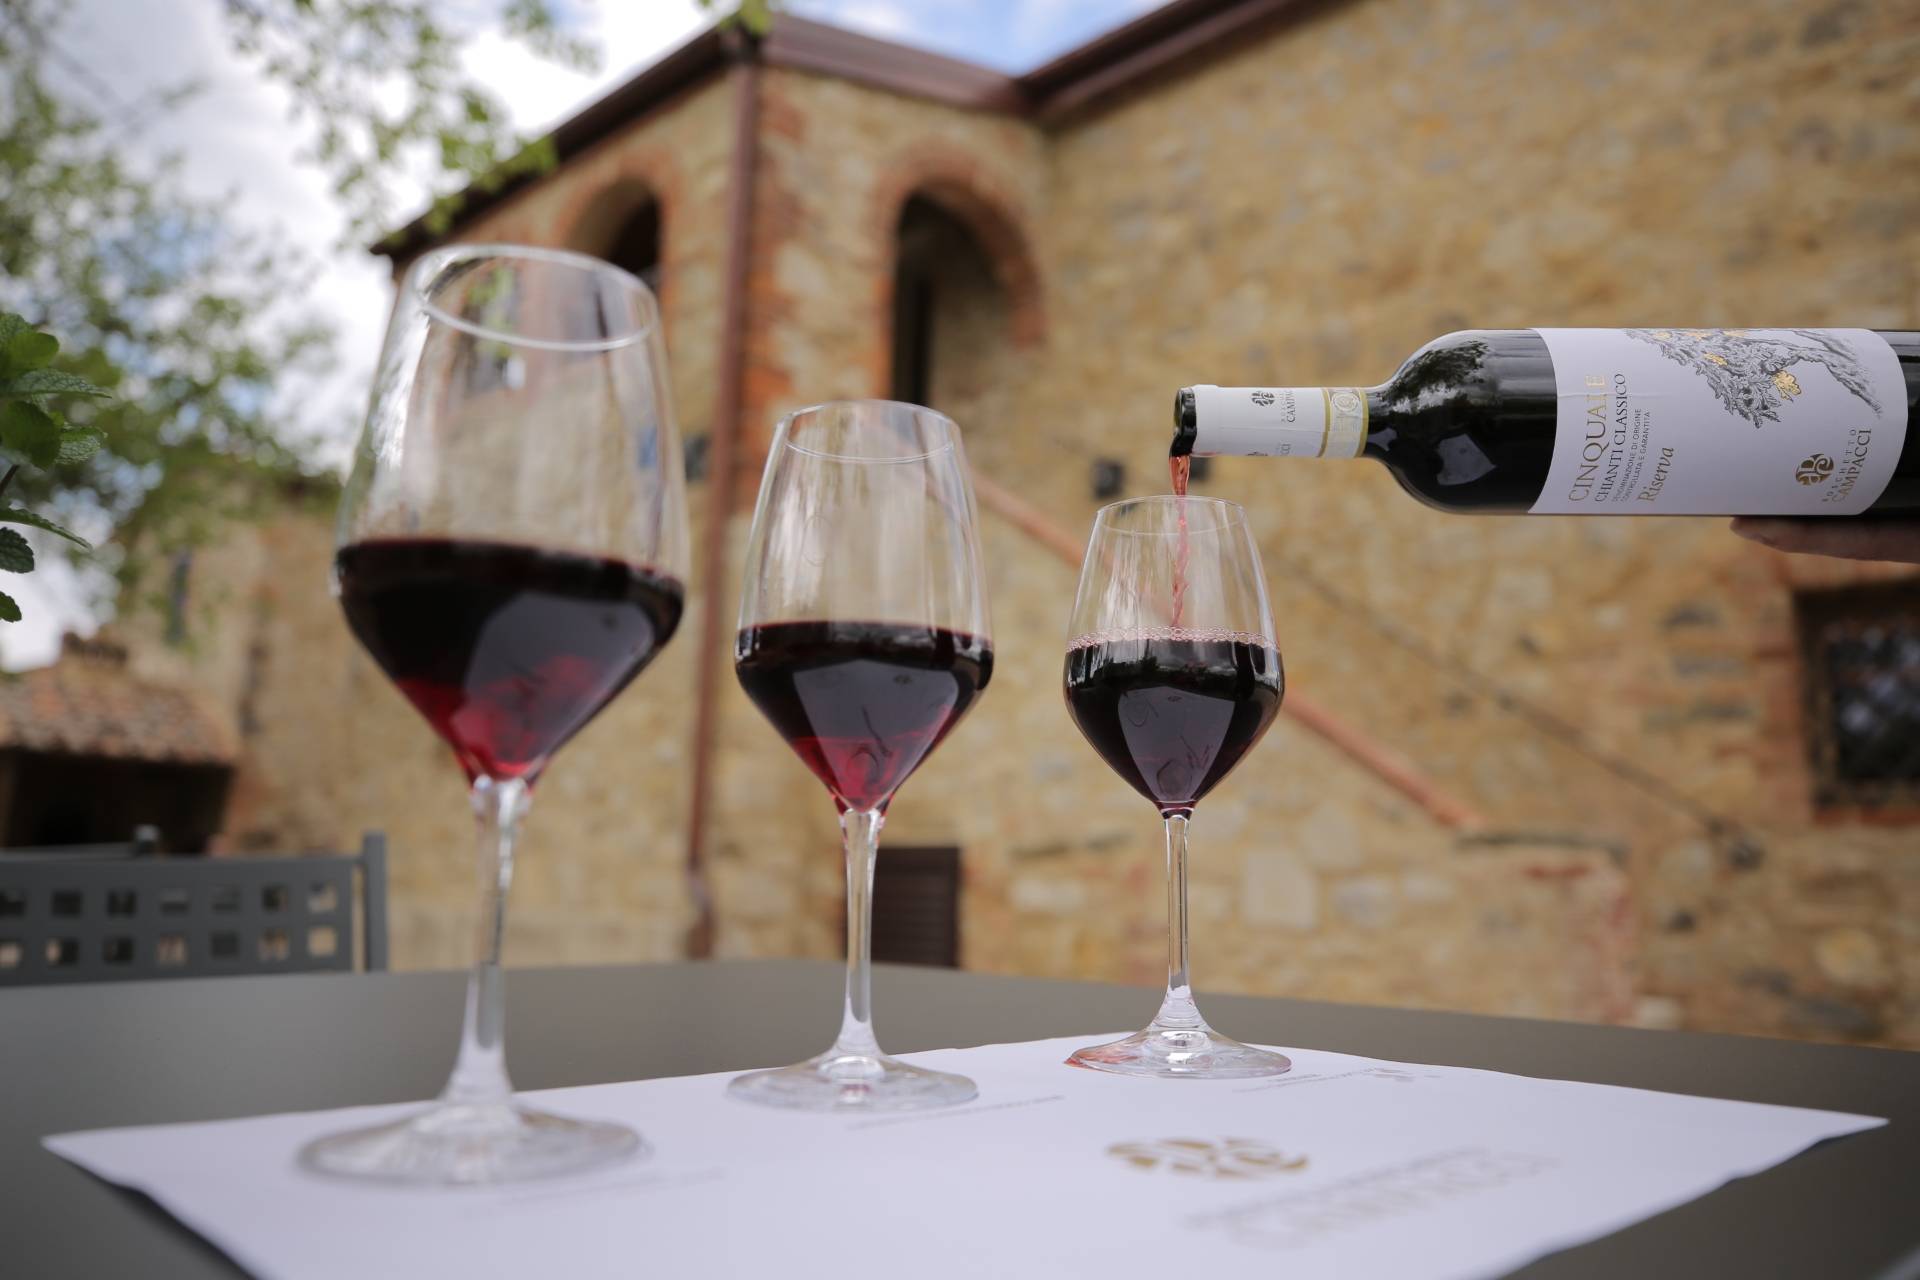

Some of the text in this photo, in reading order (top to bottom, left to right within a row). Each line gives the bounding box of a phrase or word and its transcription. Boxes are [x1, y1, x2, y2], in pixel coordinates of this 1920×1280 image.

[1594, 373, 1628, 502] CHIANTI CLASSICO
[1631, 441, 1638, 450] DI
[1632, 409, 1642, 440] ORIGINE
[1637, 447, 1675, 501] Riserva
[1831, 428, 1872, 502] CAMPACCI
